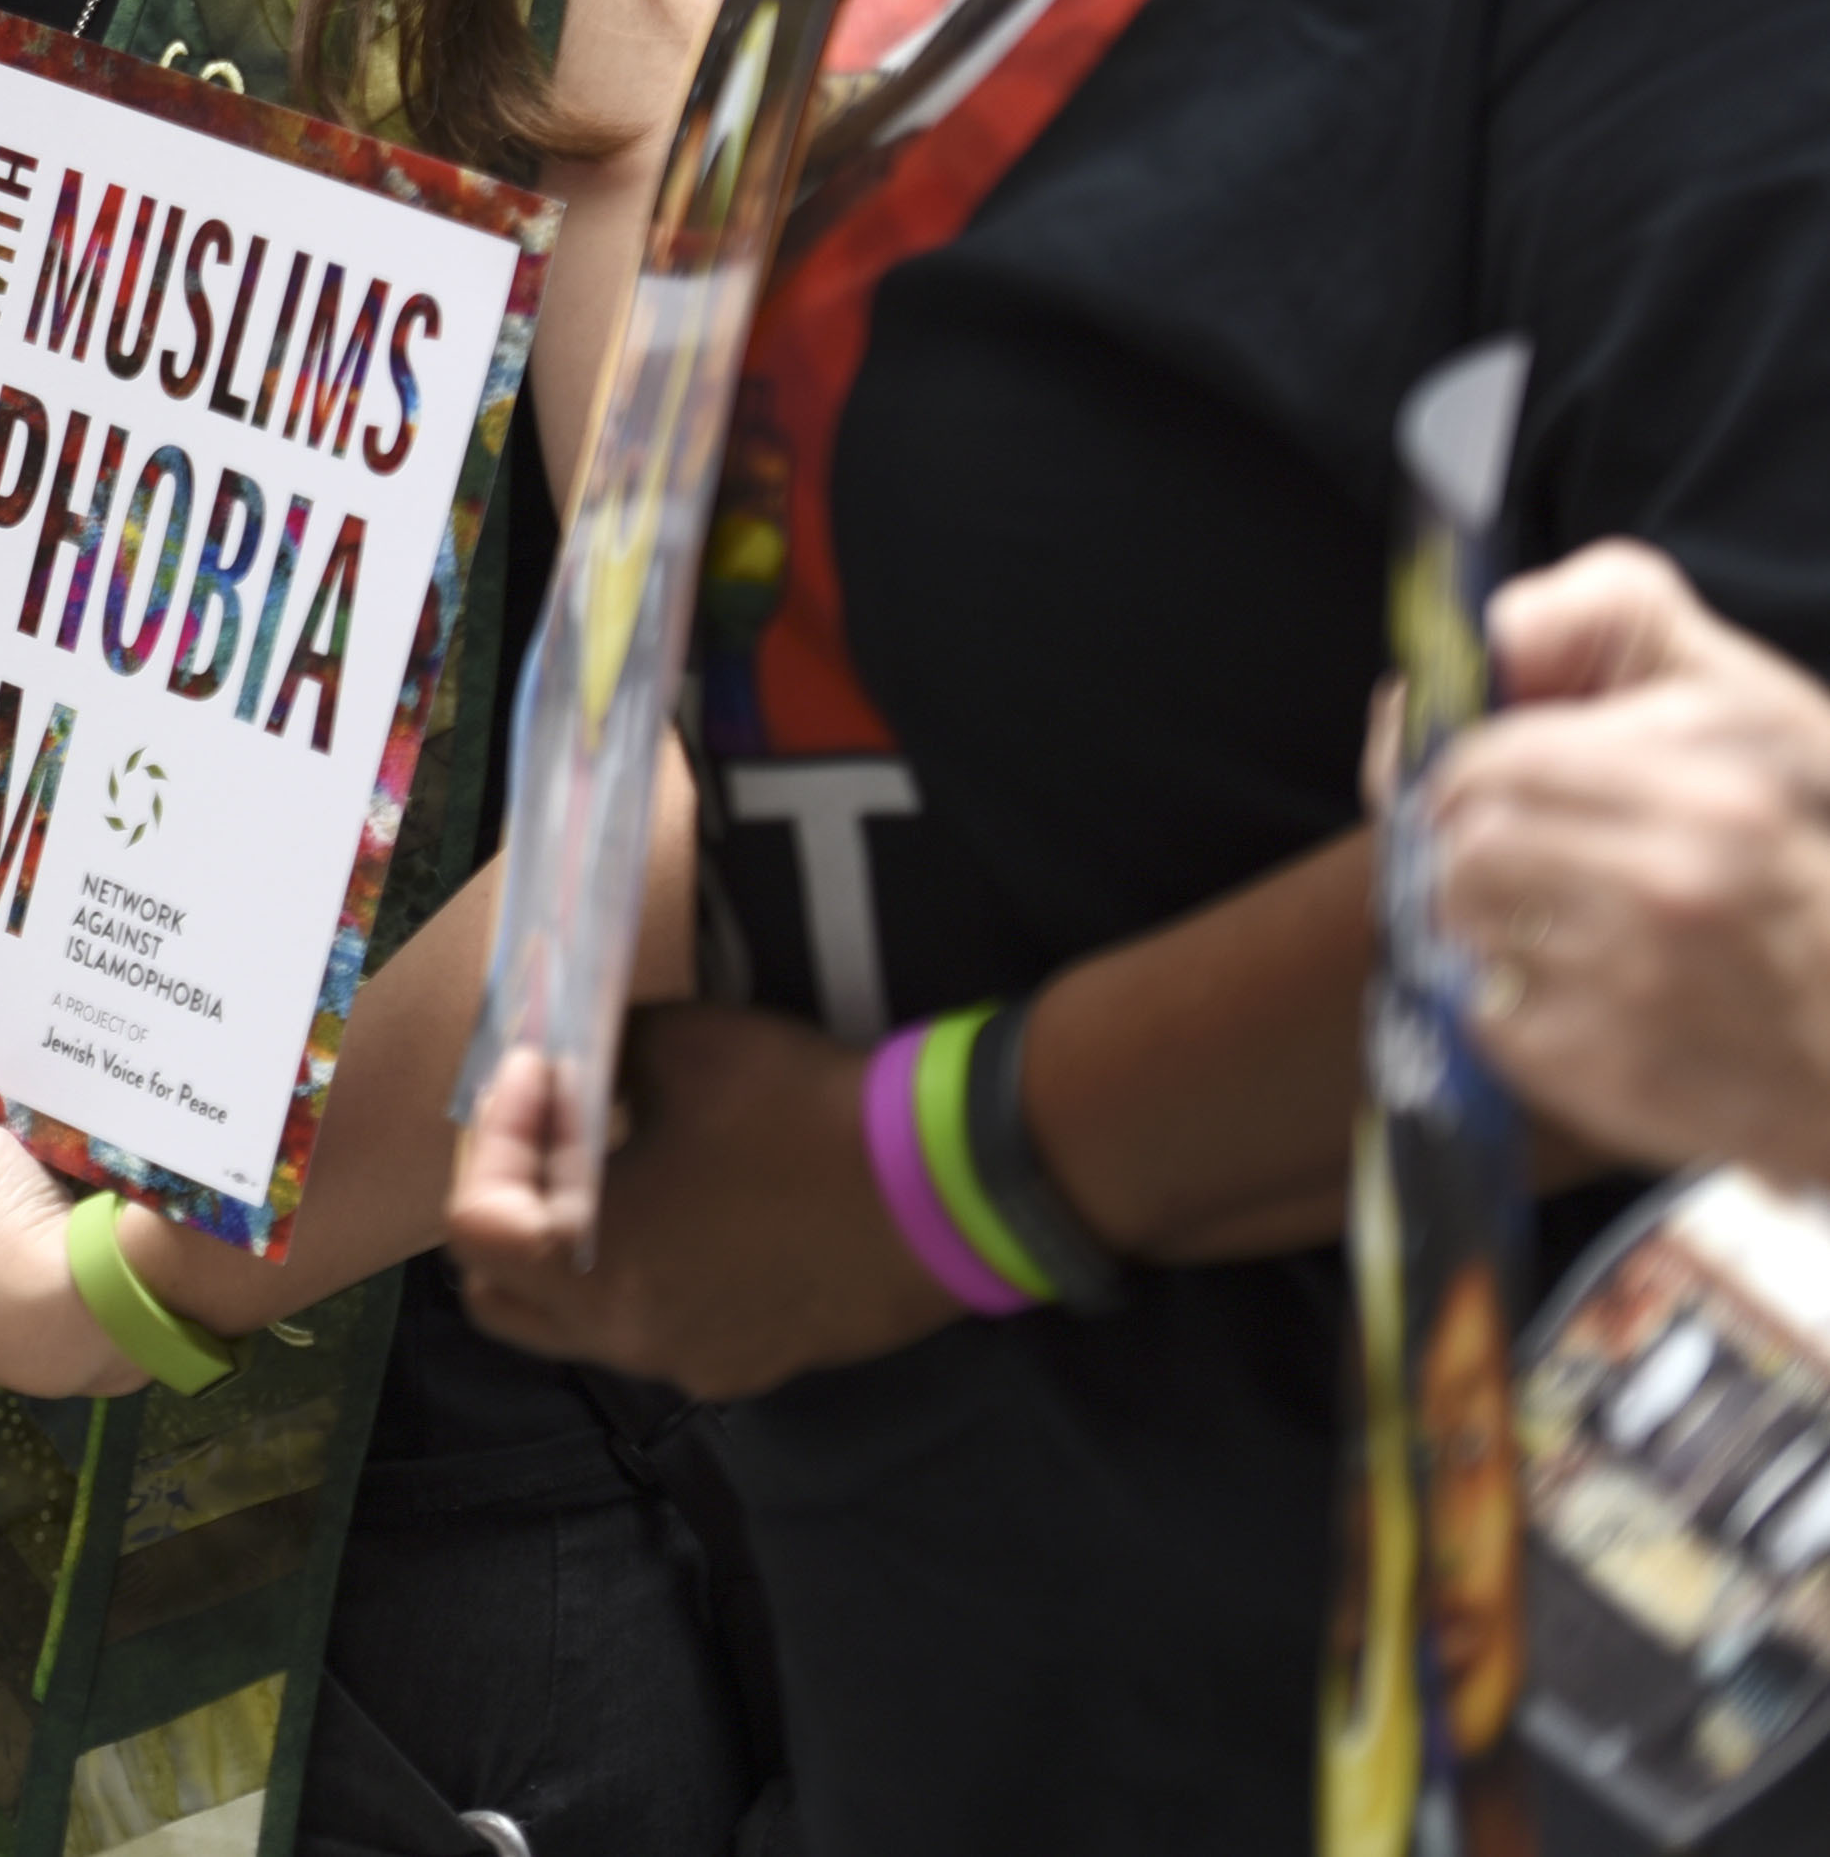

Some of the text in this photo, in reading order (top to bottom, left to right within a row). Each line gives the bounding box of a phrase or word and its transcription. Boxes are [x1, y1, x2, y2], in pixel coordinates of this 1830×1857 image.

[25, 168, 443, 476] MUSLIMS
[73, 905, 164, 960] AGAINST
[81, 872, 188, 935] NETWORK
[65, 935, 224, 1023] ISLAMOPHOBIA
[51, 993, 150, 1043] A PROJECT OF
[41, 1027, 227, 1125] Jewish Voice for Peace
